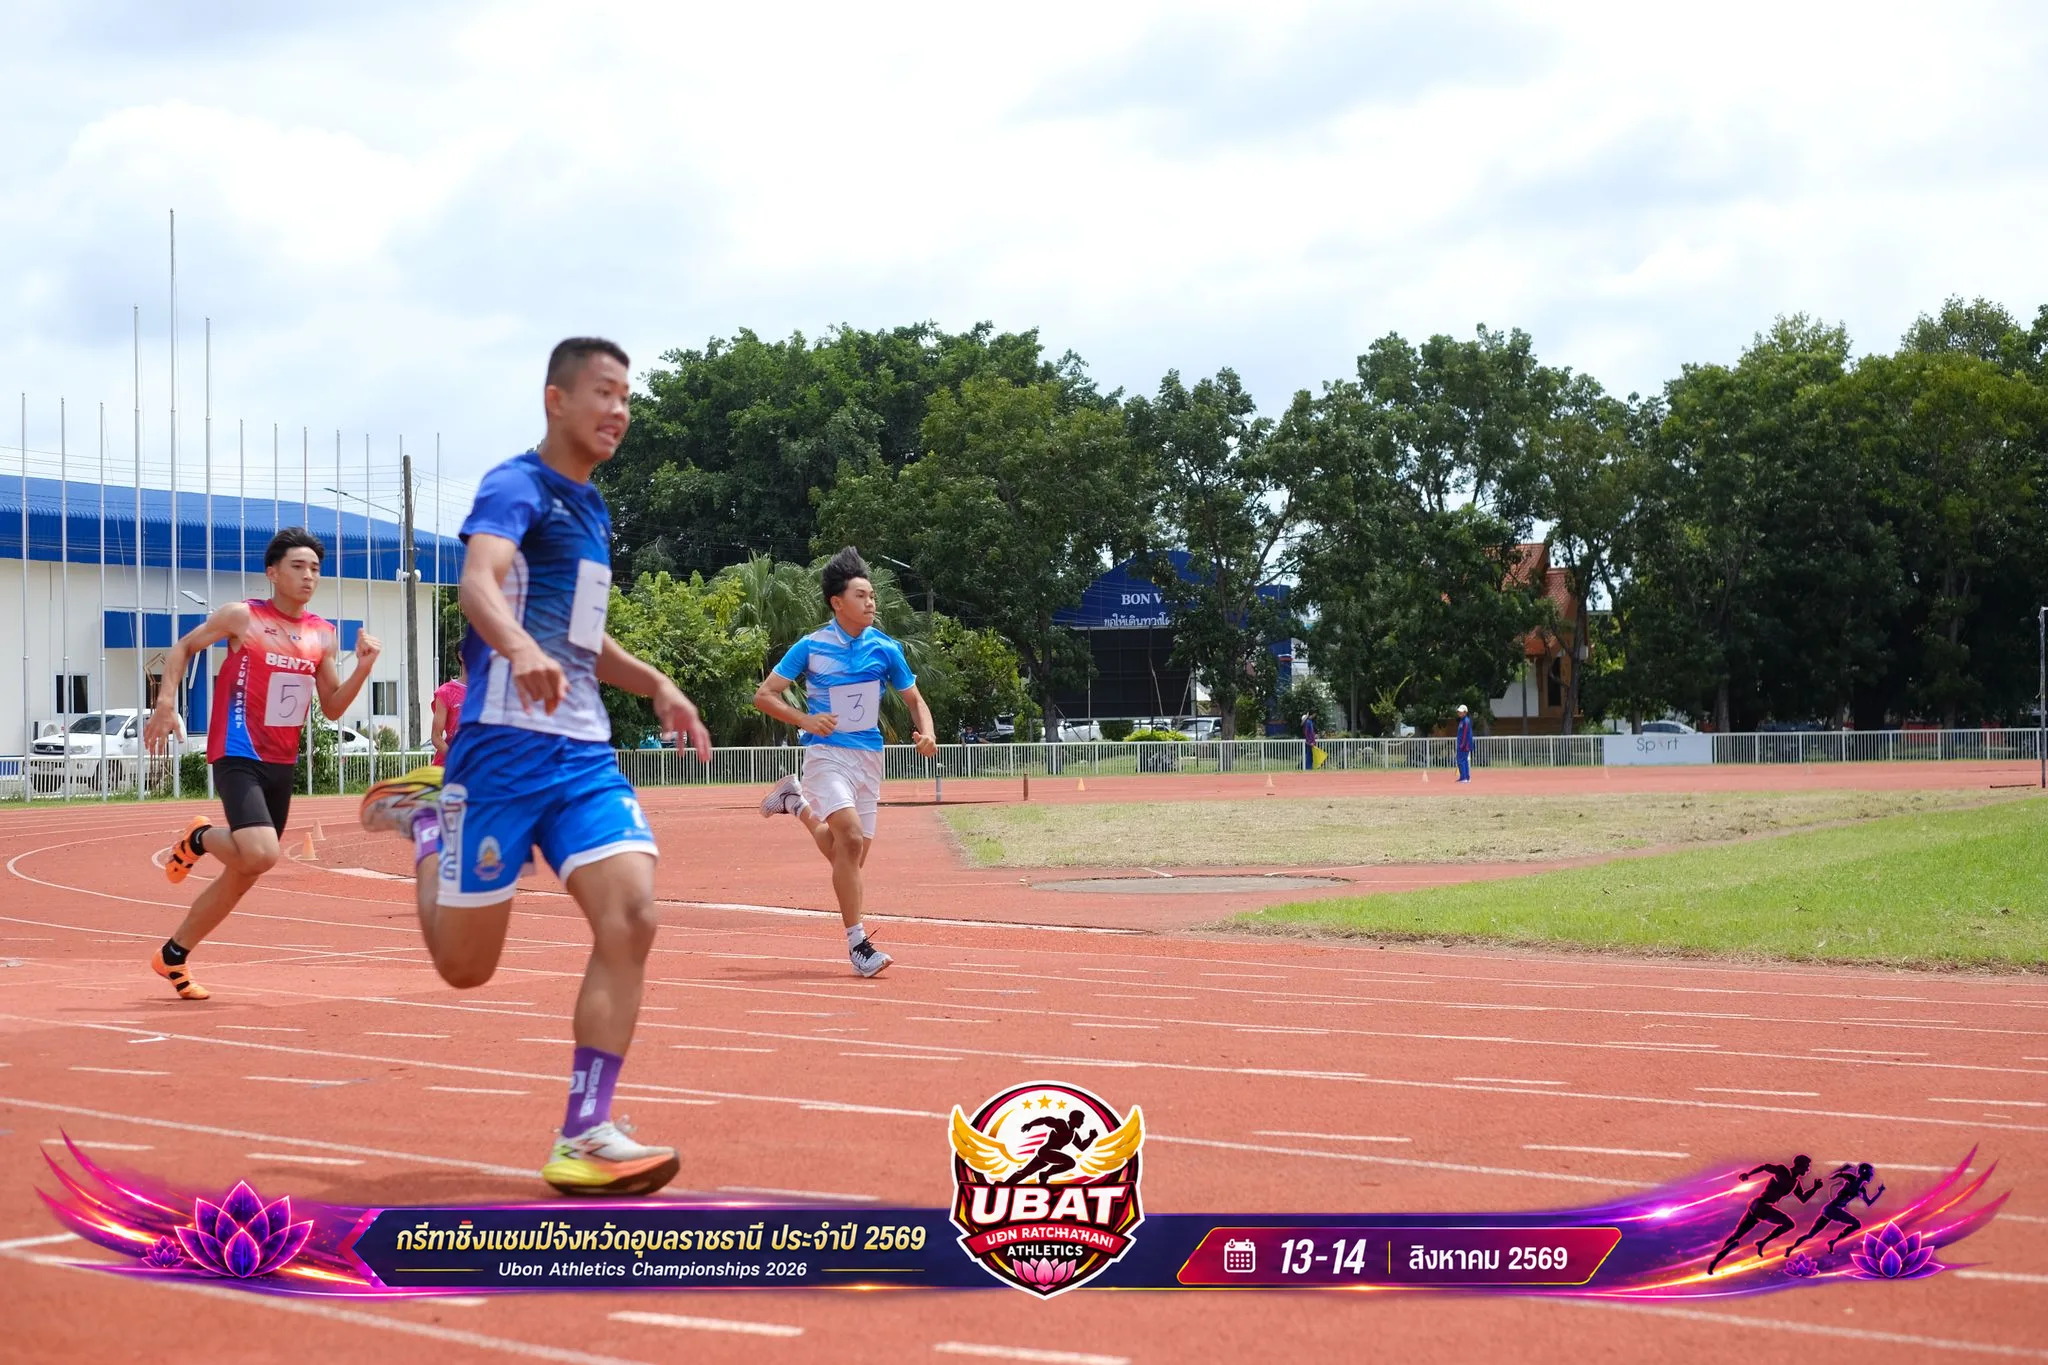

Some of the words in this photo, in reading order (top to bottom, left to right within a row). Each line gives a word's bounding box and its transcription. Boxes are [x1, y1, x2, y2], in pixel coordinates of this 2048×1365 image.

[1121, 593, 1151, 605] BON
[237, 655, 249, 686] CLUB
[234, 692, 244, 729] SPORT
[279, 684, 301, 719] 5
[847, 693, 865, 722] 3
[1636, 737, 1680, 754] Sprt
